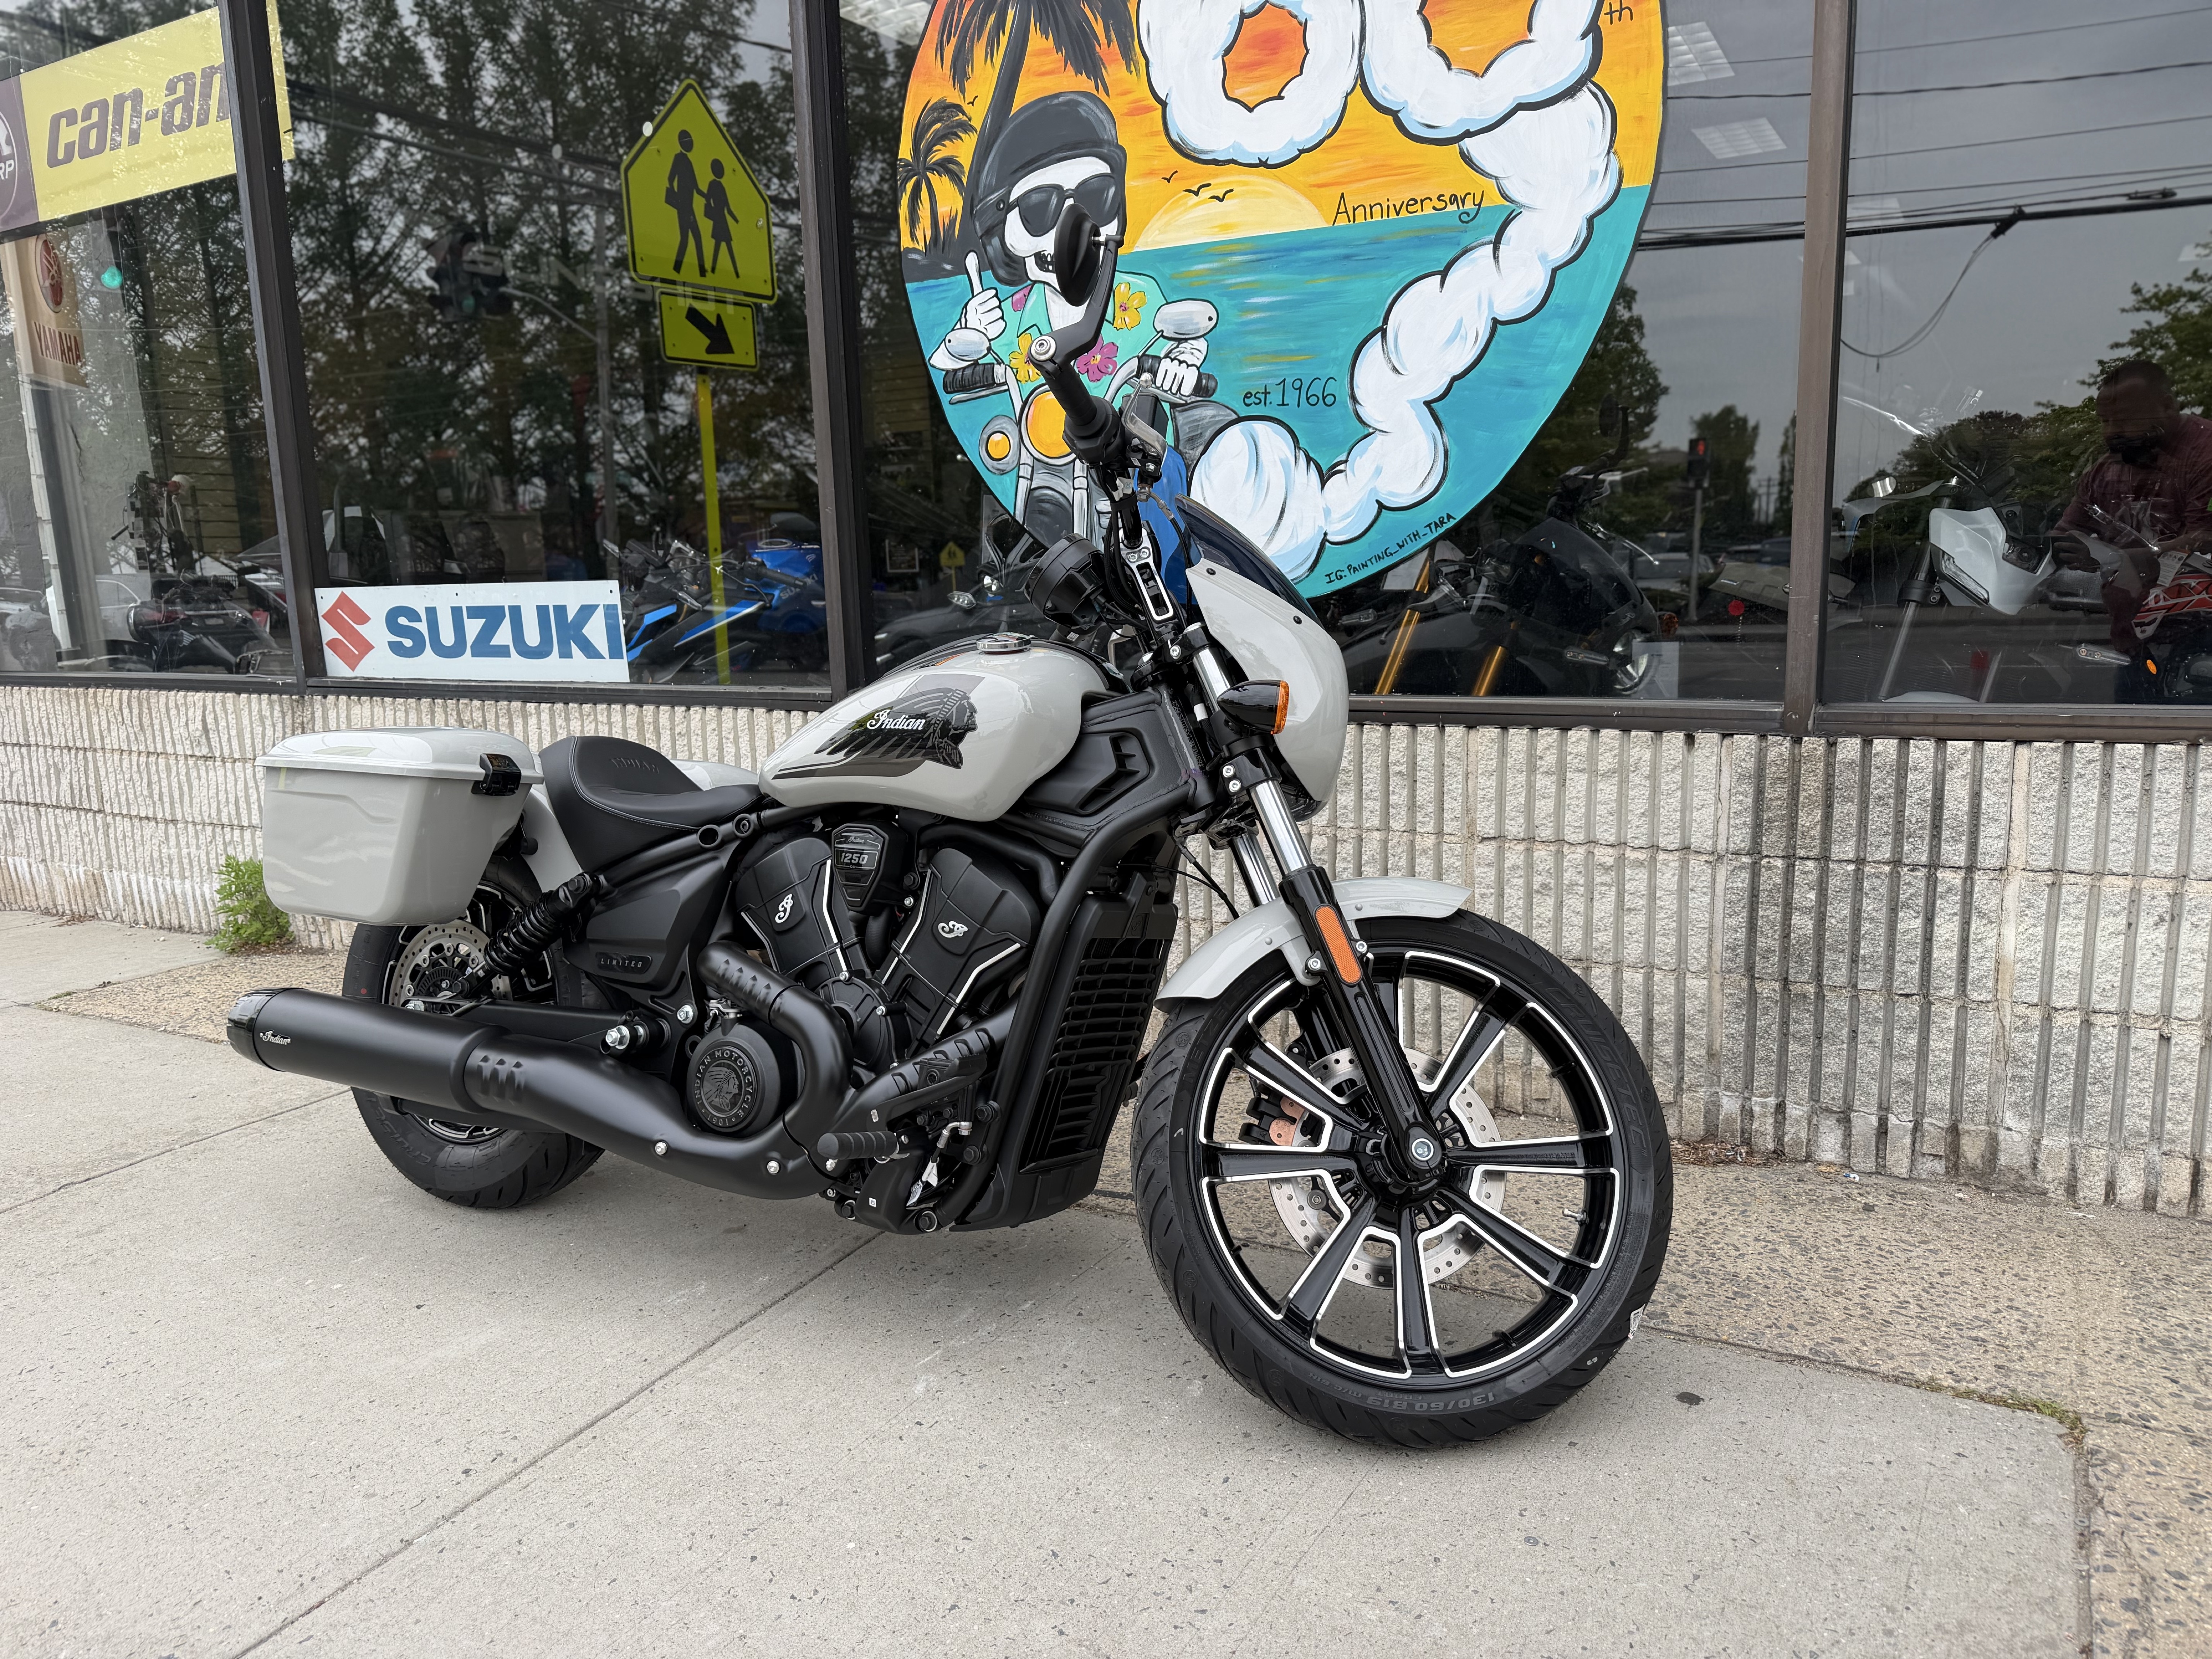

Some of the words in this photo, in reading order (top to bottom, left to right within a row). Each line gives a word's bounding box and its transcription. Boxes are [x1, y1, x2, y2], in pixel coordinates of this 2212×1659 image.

[1332, 190, 1484, 226] Anniversary
[34, 321, 82, 366] YAMAHA
[385, 604, 624, 660] SUZUKI
[867, 709, 926, 731] Indian
[609, 757, 660, 774] INDIAN
[841, 853, 868, 864] 1250
[600, 959, 643, 968] LIMITED
[263, 1030, 289, 1046] Indian
[1183, 973, 1260, 1084] METZELER
[695, 1056, 711, 1105] INDIAN
[715, 1049, 753, 1117] MOTORCYCLE
[1367, 1397, 1408, 1410] B19
[1415, 1392, 1494, 1411] 130/60
